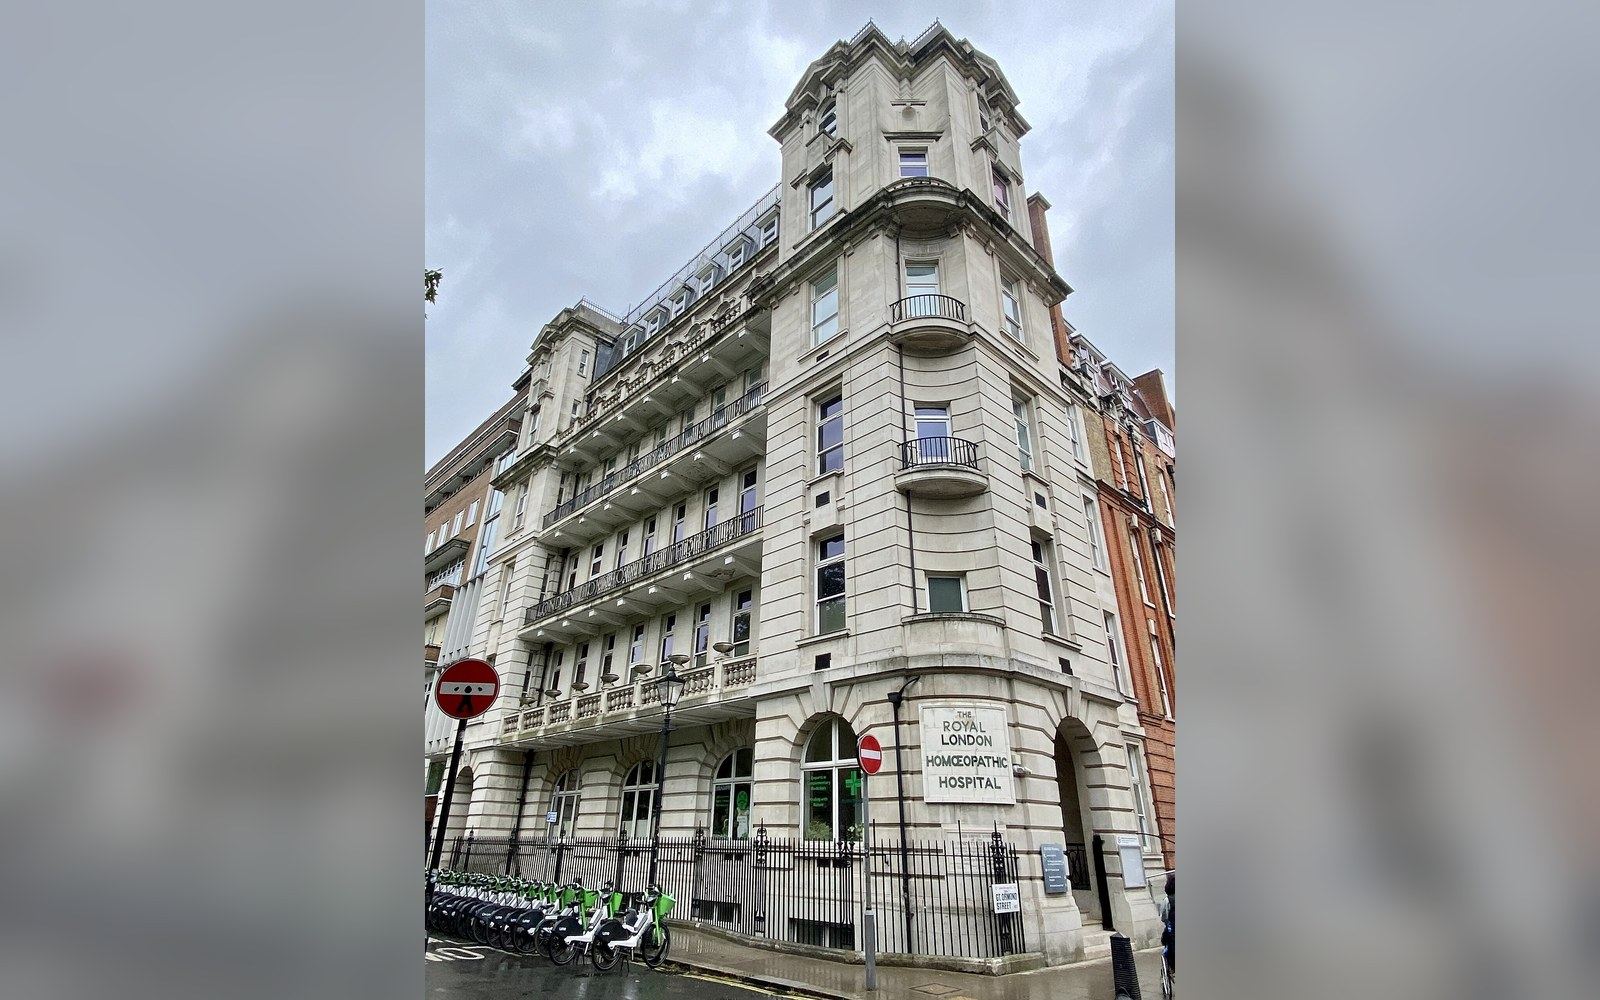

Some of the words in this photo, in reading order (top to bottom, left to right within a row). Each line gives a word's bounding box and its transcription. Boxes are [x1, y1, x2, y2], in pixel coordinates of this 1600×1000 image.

[943, 721, 986, 733] ROYAL
[941, 734, 992, 747] LONDON
[939, 776, 1001, 789] HOSPITAL
[996, 902, 1012, 910] STREET
